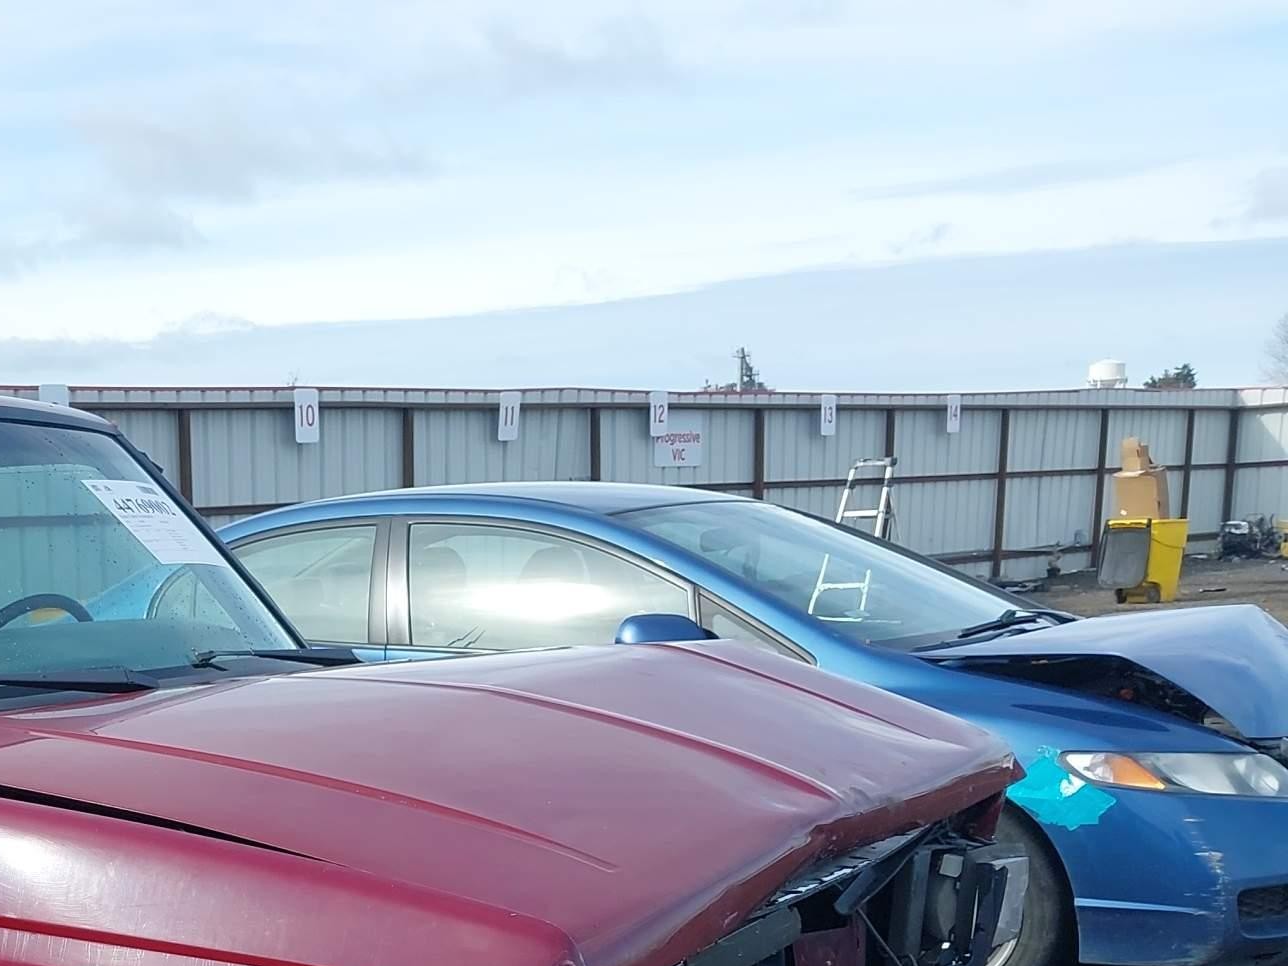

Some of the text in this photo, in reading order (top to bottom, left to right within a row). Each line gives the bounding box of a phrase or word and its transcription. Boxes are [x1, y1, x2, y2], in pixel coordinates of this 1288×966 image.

[299, 404, 315, 427] 10
[504, 406, 515, 426] 11
[654, 404, 665, 423] 12
[824, 406, 833, 424] 13
[949, 405, 958, 421] 14
[672, 448, 686, 461] VIC
[113, 498, 176, 516] 44769002
